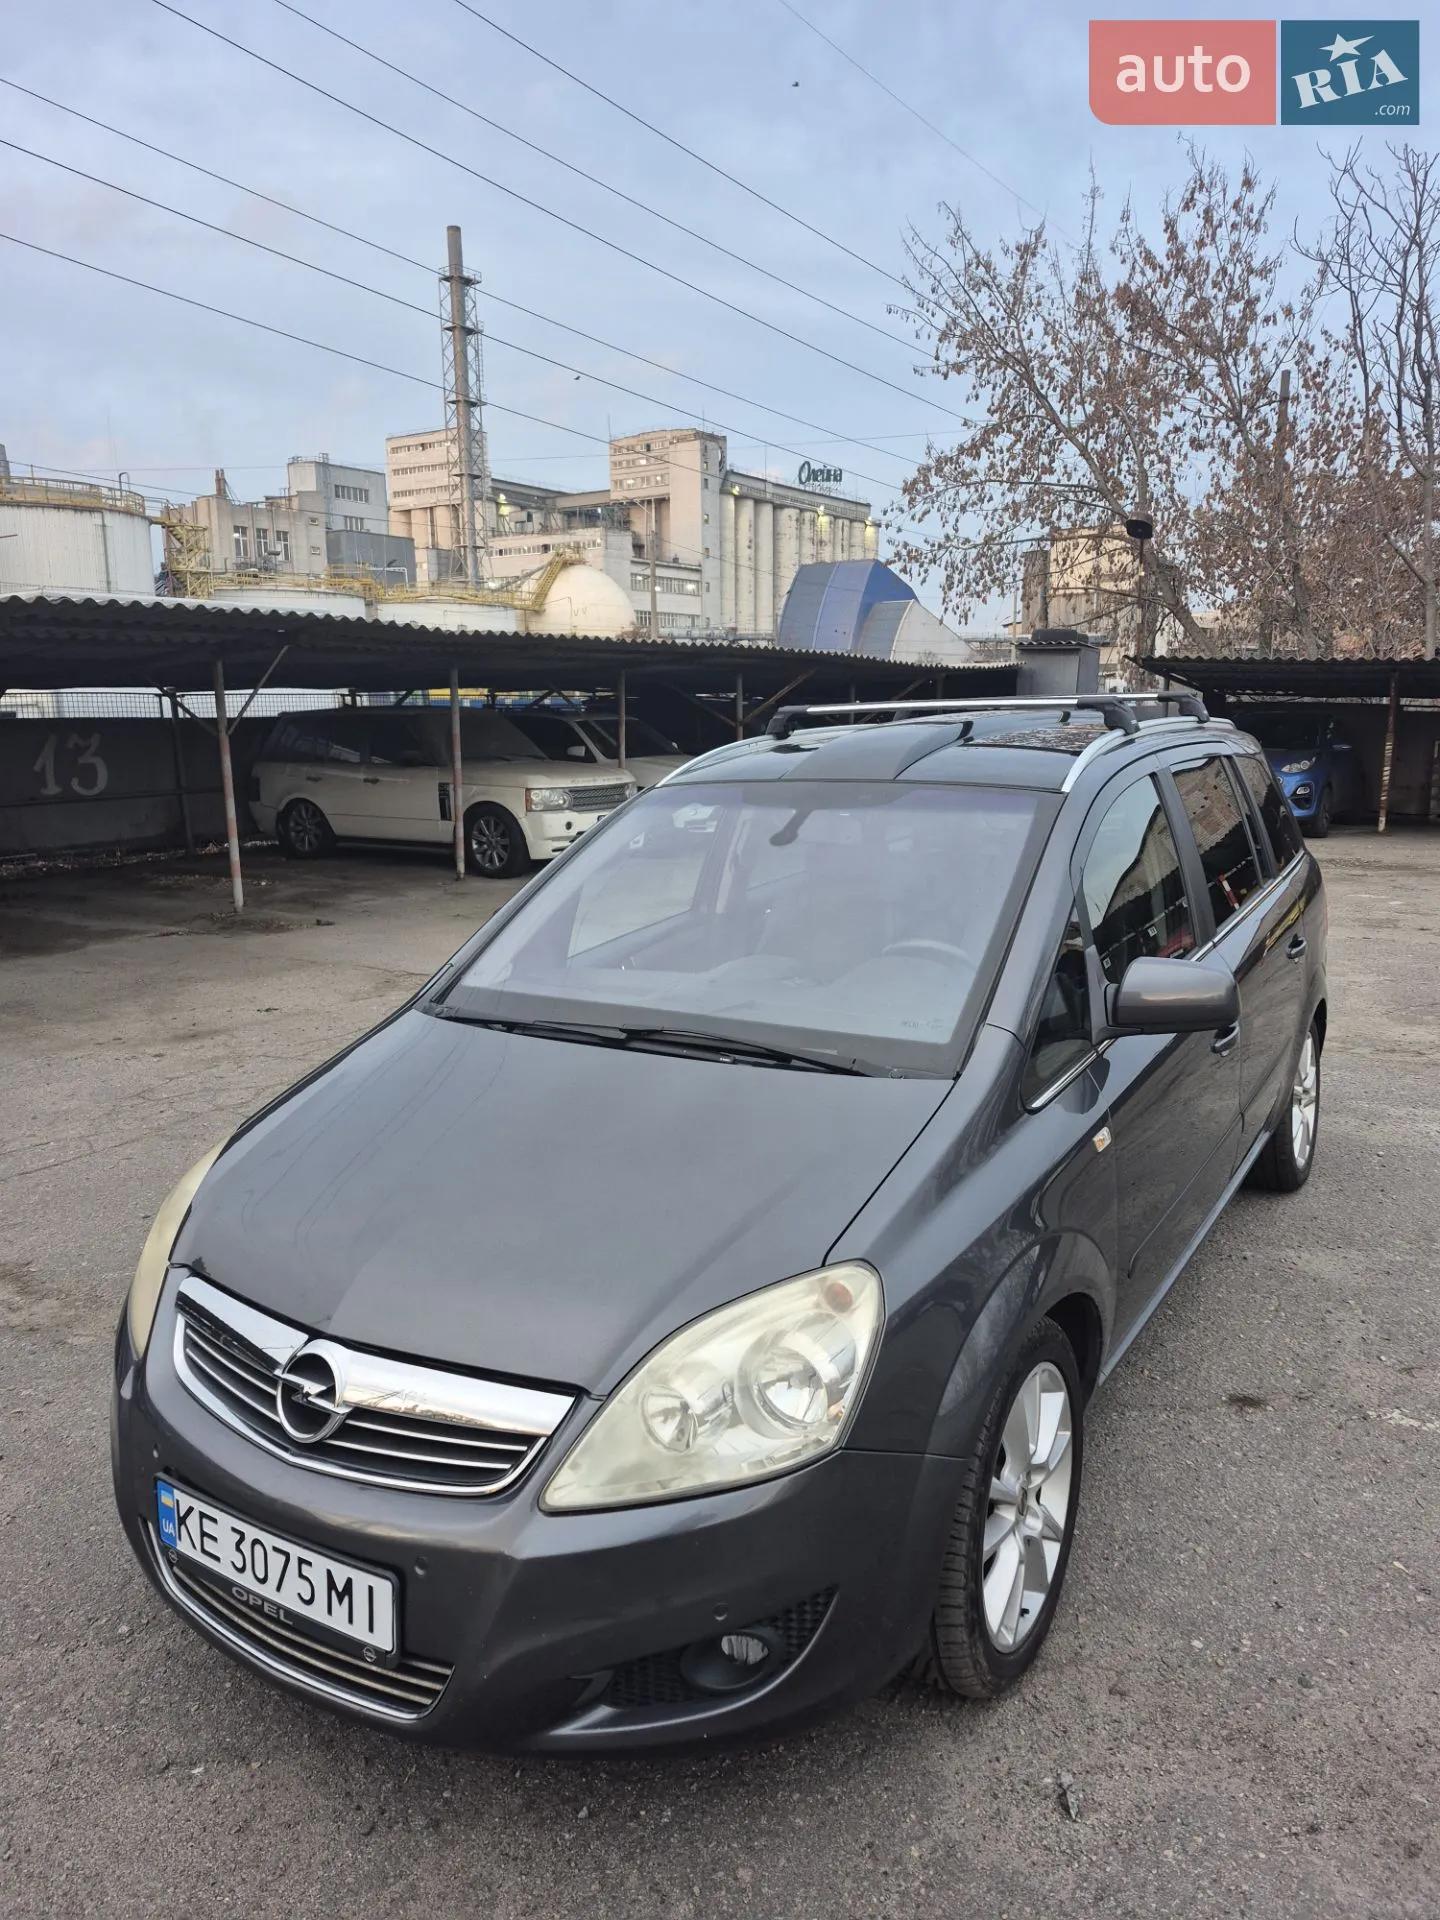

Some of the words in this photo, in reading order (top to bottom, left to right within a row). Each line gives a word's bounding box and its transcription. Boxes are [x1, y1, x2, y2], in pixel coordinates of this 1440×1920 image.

[33, 732, 108, 796] 13
[162, 1518, 175, 1538] UA
[231, 1586, 293, 1626] OPEL
